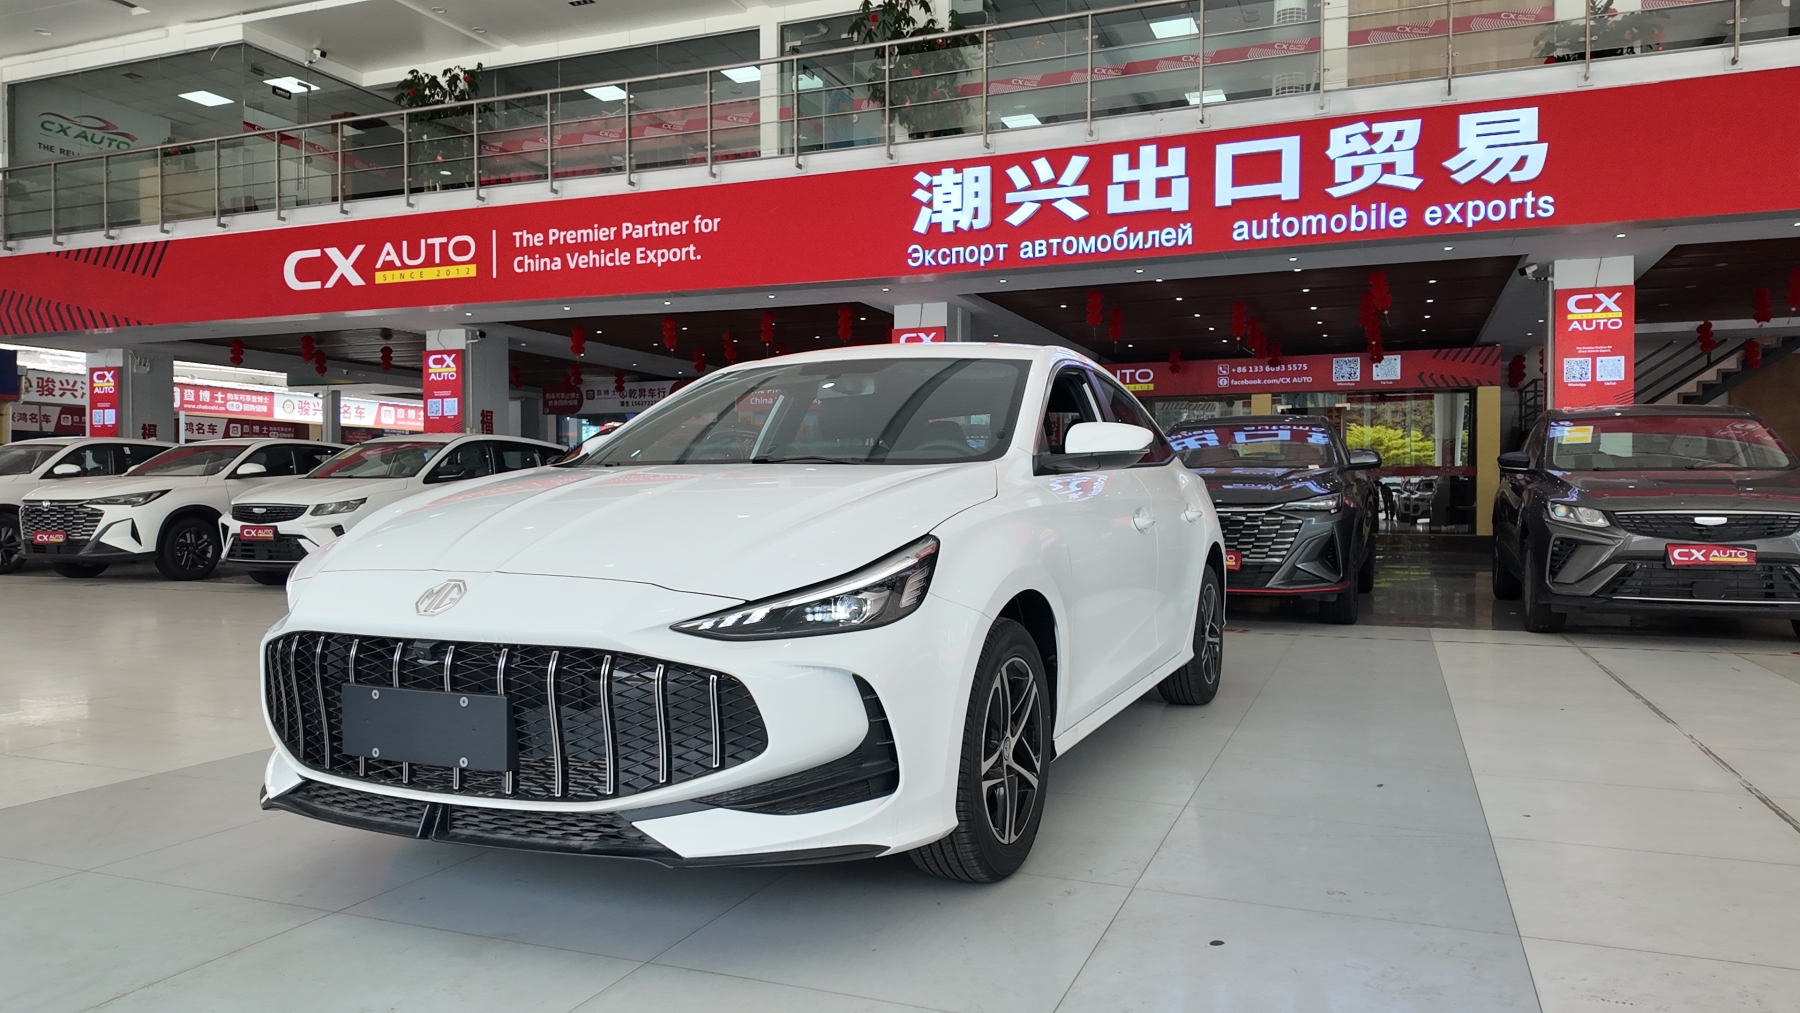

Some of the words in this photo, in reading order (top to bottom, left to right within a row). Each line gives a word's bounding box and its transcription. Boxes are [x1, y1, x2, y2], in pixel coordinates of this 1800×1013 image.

[1501, 12, 1516, 20] CX
[1396, 25, 1412, 33] CX
[40, 120, 72, 136] CX
[73, 130, 131, 150] AUTO
[37, 142, 56, 154] THE
[911, 107, 1549, 235] 潮兴出口贸易
[1231, 202, 1407, 242] automobile
[1424, 190, 1555, 228] exports
[513, 230, 544, 248] The
[548, 224, 617, 246] Premier
[622, 220, 689, 240] Partner
[694, 214, 721, 234] for
[907, 243, 1008, 267] Экспорт
[1019, 222, 1193, 259] автомобилей
[283, 244, 366, 291] CX
[375, 235, 476, 269] AUTO
[513, 254, 562, 273] China
[566, 248, 630, 270] Vehicle
[636, 244, 702, 268] Export.
[382, 270, 424, 281] SINCE
[436, 267, 470, 277] 2012
[1567, 292, 1622, 314] CX
[1568, 319, 1622, 332] AUTO
[900, 332, 936, 344] CX
[428, 354, 456, 368] CX
[93, 370, 114, 382] CX
[429, 372, 456, 380] AUTO
[184, 388, 225, 404] 查博士
[750, 396, 773, 404] China
[480, 410, 494, 434] 福
[1673, 548, 1706, 561] CX
[1710, 550, 1748, 558] AUTO
[418, 580, 465, 614] MG
